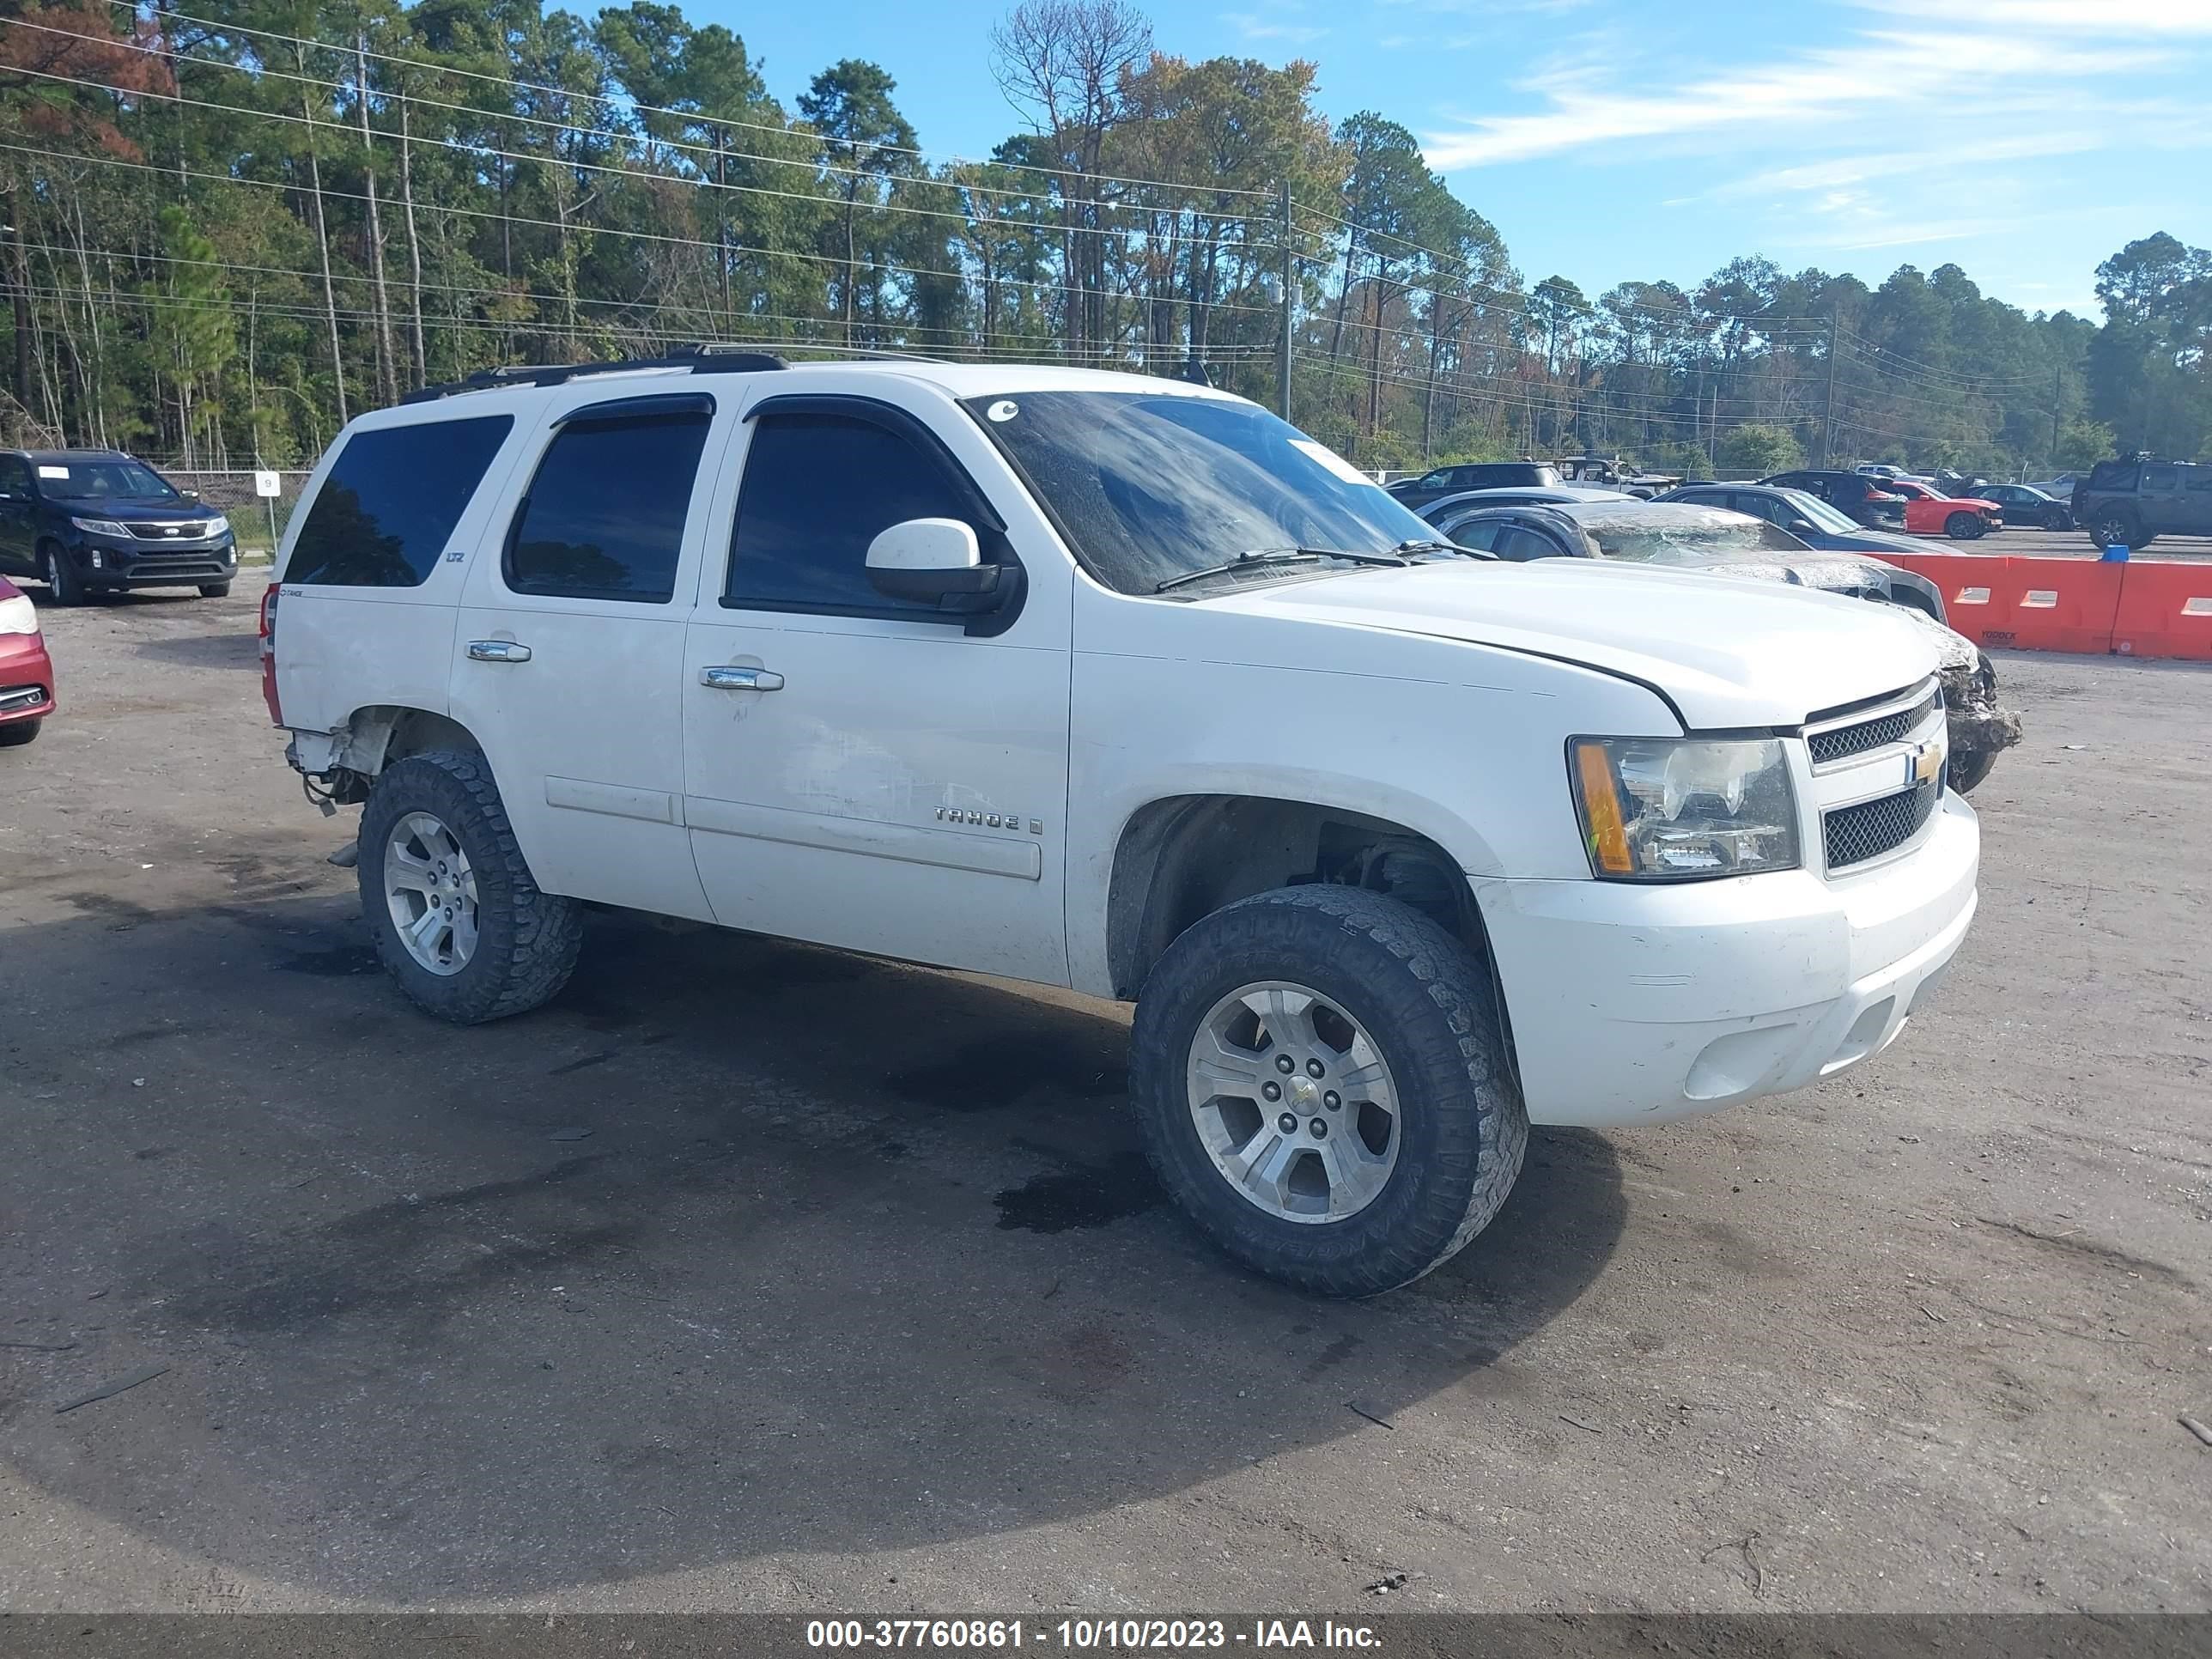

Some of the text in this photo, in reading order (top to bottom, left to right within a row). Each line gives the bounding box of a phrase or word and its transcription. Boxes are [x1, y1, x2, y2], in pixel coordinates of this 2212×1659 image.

[265, 478, 272, 489] 9
[446, 552, 465, 563] LTZ
[1980, 629, 2018, 640] YODOCK
[933, 805, 1020, 831] TAHOE
